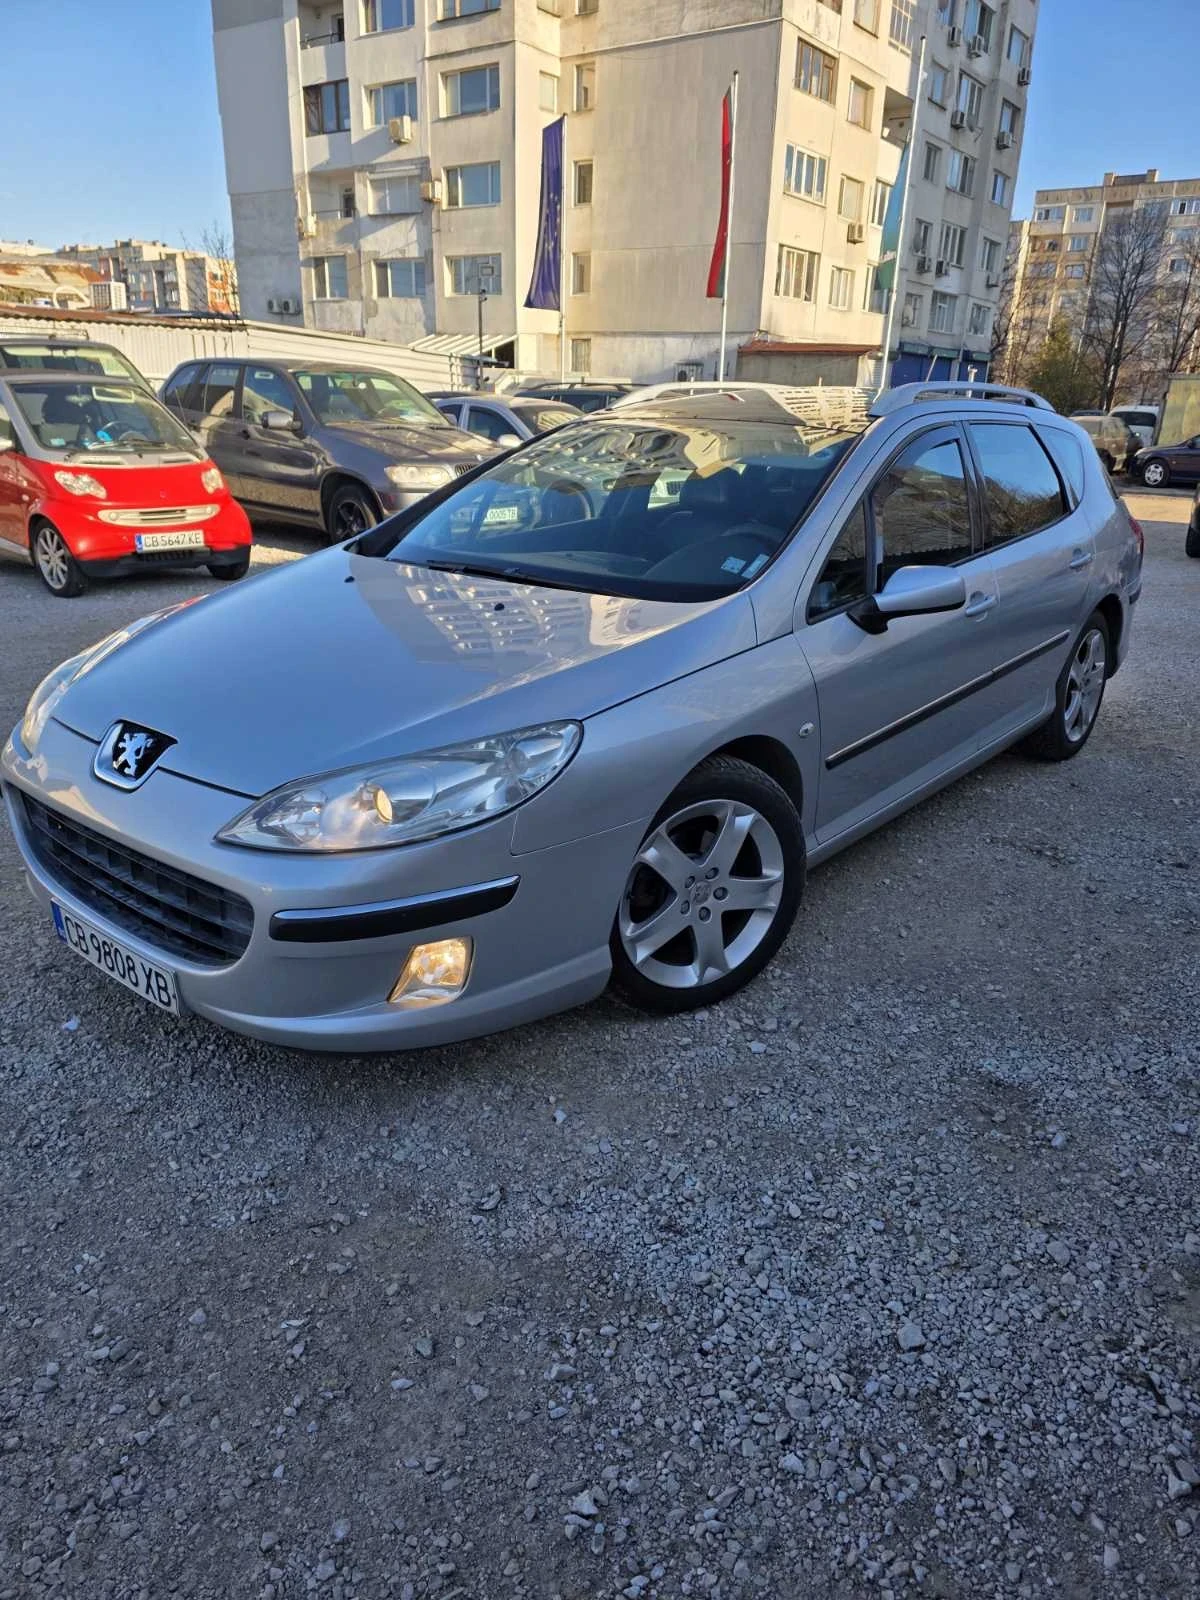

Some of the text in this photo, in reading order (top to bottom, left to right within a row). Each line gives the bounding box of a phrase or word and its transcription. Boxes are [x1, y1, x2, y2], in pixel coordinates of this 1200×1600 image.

[144, 532, 202, 548] CB 5647 KE
[64, 914, 171, 1008] CB 9808 XB
